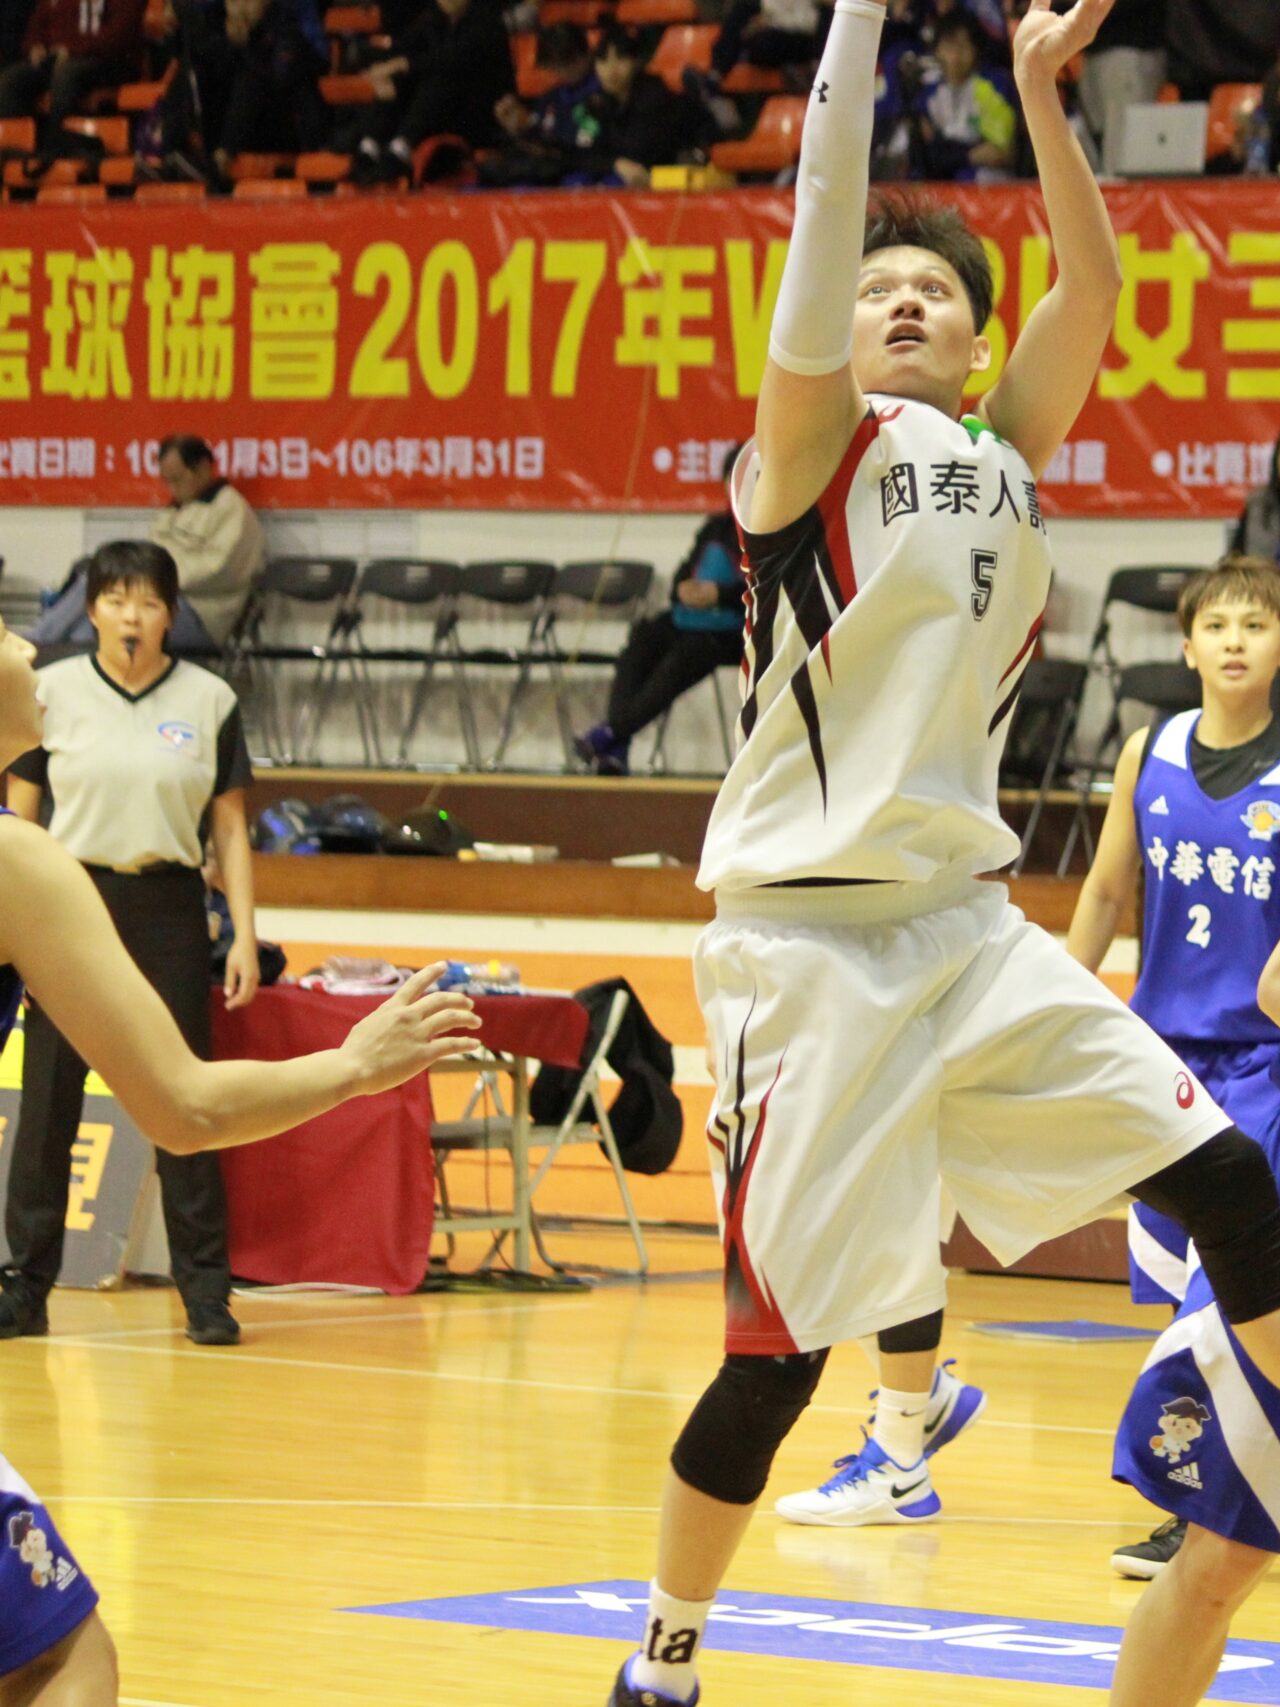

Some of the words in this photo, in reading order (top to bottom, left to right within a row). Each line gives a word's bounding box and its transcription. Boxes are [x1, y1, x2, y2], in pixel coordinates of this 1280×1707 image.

[970, 548, 998, 622] 5
[1147, 836, 1276, 900] 中華電信
[1185, 903, 1212, 949] 2
[1167, 1471, 1204, 1491] adidas
